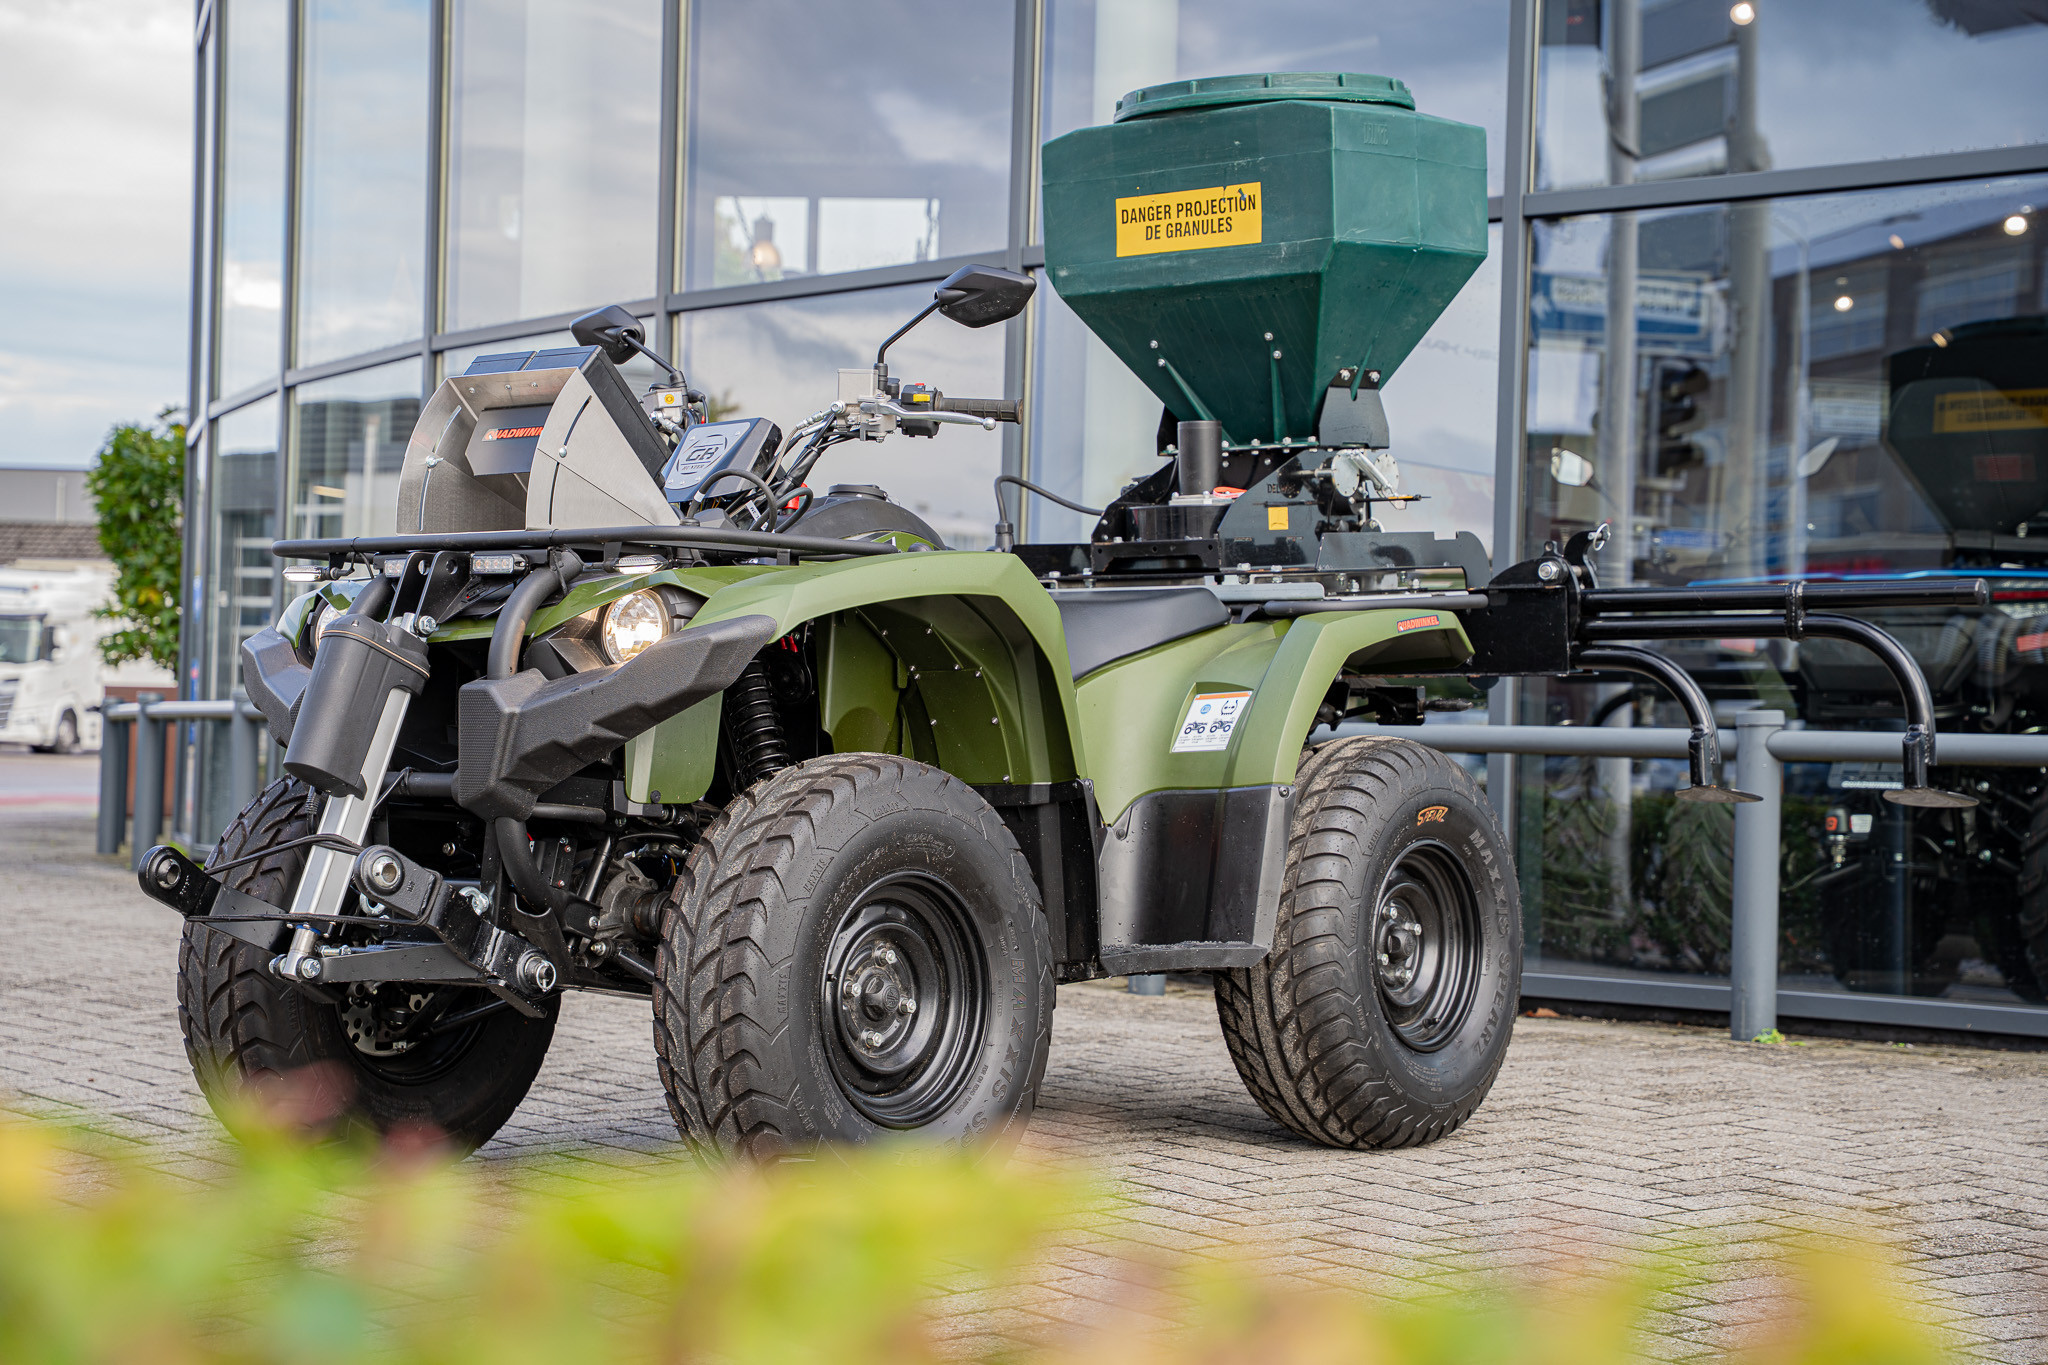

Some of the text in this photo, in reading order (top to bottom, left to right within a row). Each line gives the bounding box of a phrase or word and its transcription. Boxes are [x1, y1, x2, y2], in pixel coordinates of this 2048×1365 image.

[1121, 194, 1256, 224] DANGER PROJECTION
[1145, 216, 1233, 241] DE GRANULES
[1397, 615, 1440, 632] QUADWINKEL
[1417, 805, 1449, 826] SPEARZ
[1469, 829, 1509, 938] MAXXIS
[1472, 951, 1512, 1057] SPEARZ
[991, 958, 1028, 1103] MAXXIS
